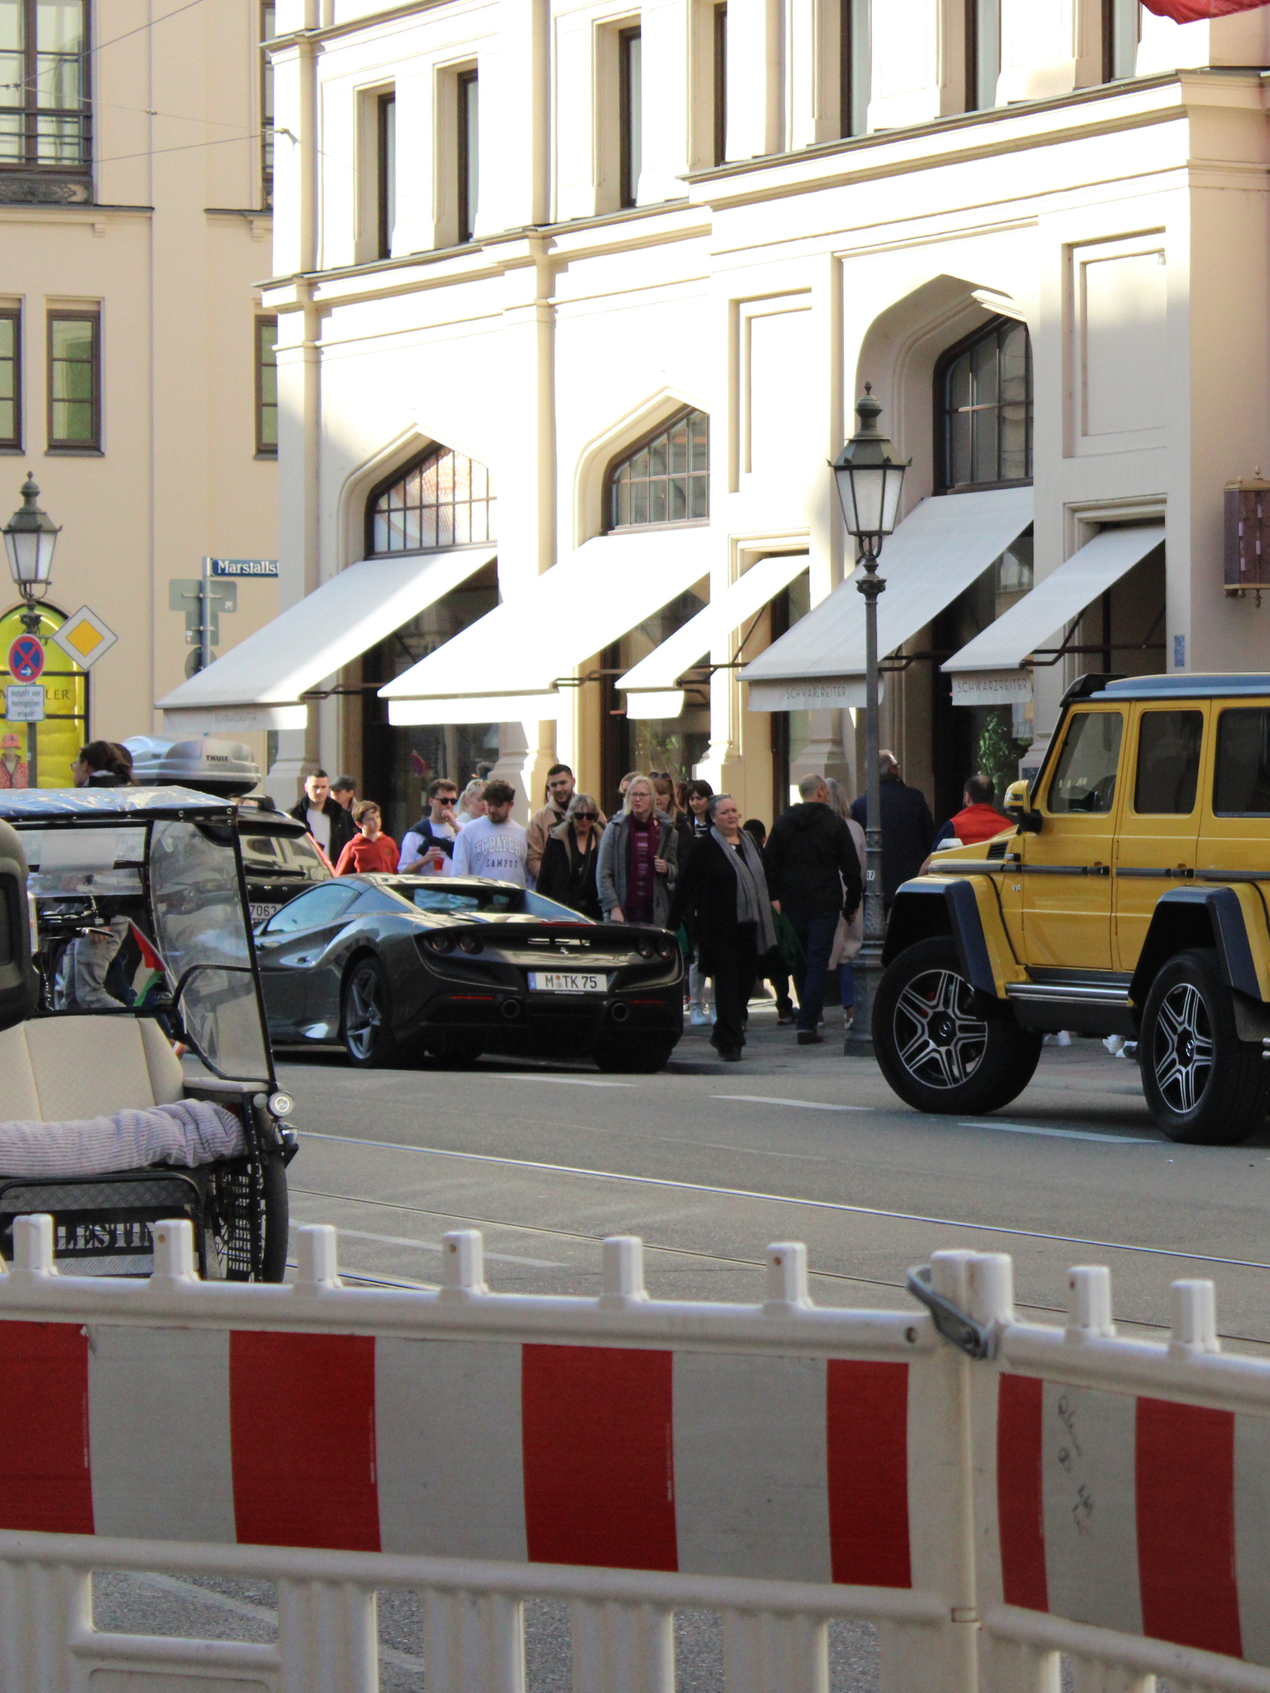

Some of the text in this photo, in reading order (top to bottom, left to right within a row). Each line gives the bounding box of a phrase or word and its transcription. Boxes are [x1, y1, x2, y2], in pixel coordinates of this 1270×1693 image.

[786, 686, 847, 699] SCHWARZREITER
[957, 679, 1027, 693] SCHWARZREITER
[486, 859, 518, 869] CAMPUS
[544, 974, 597, 989] M TK 75
